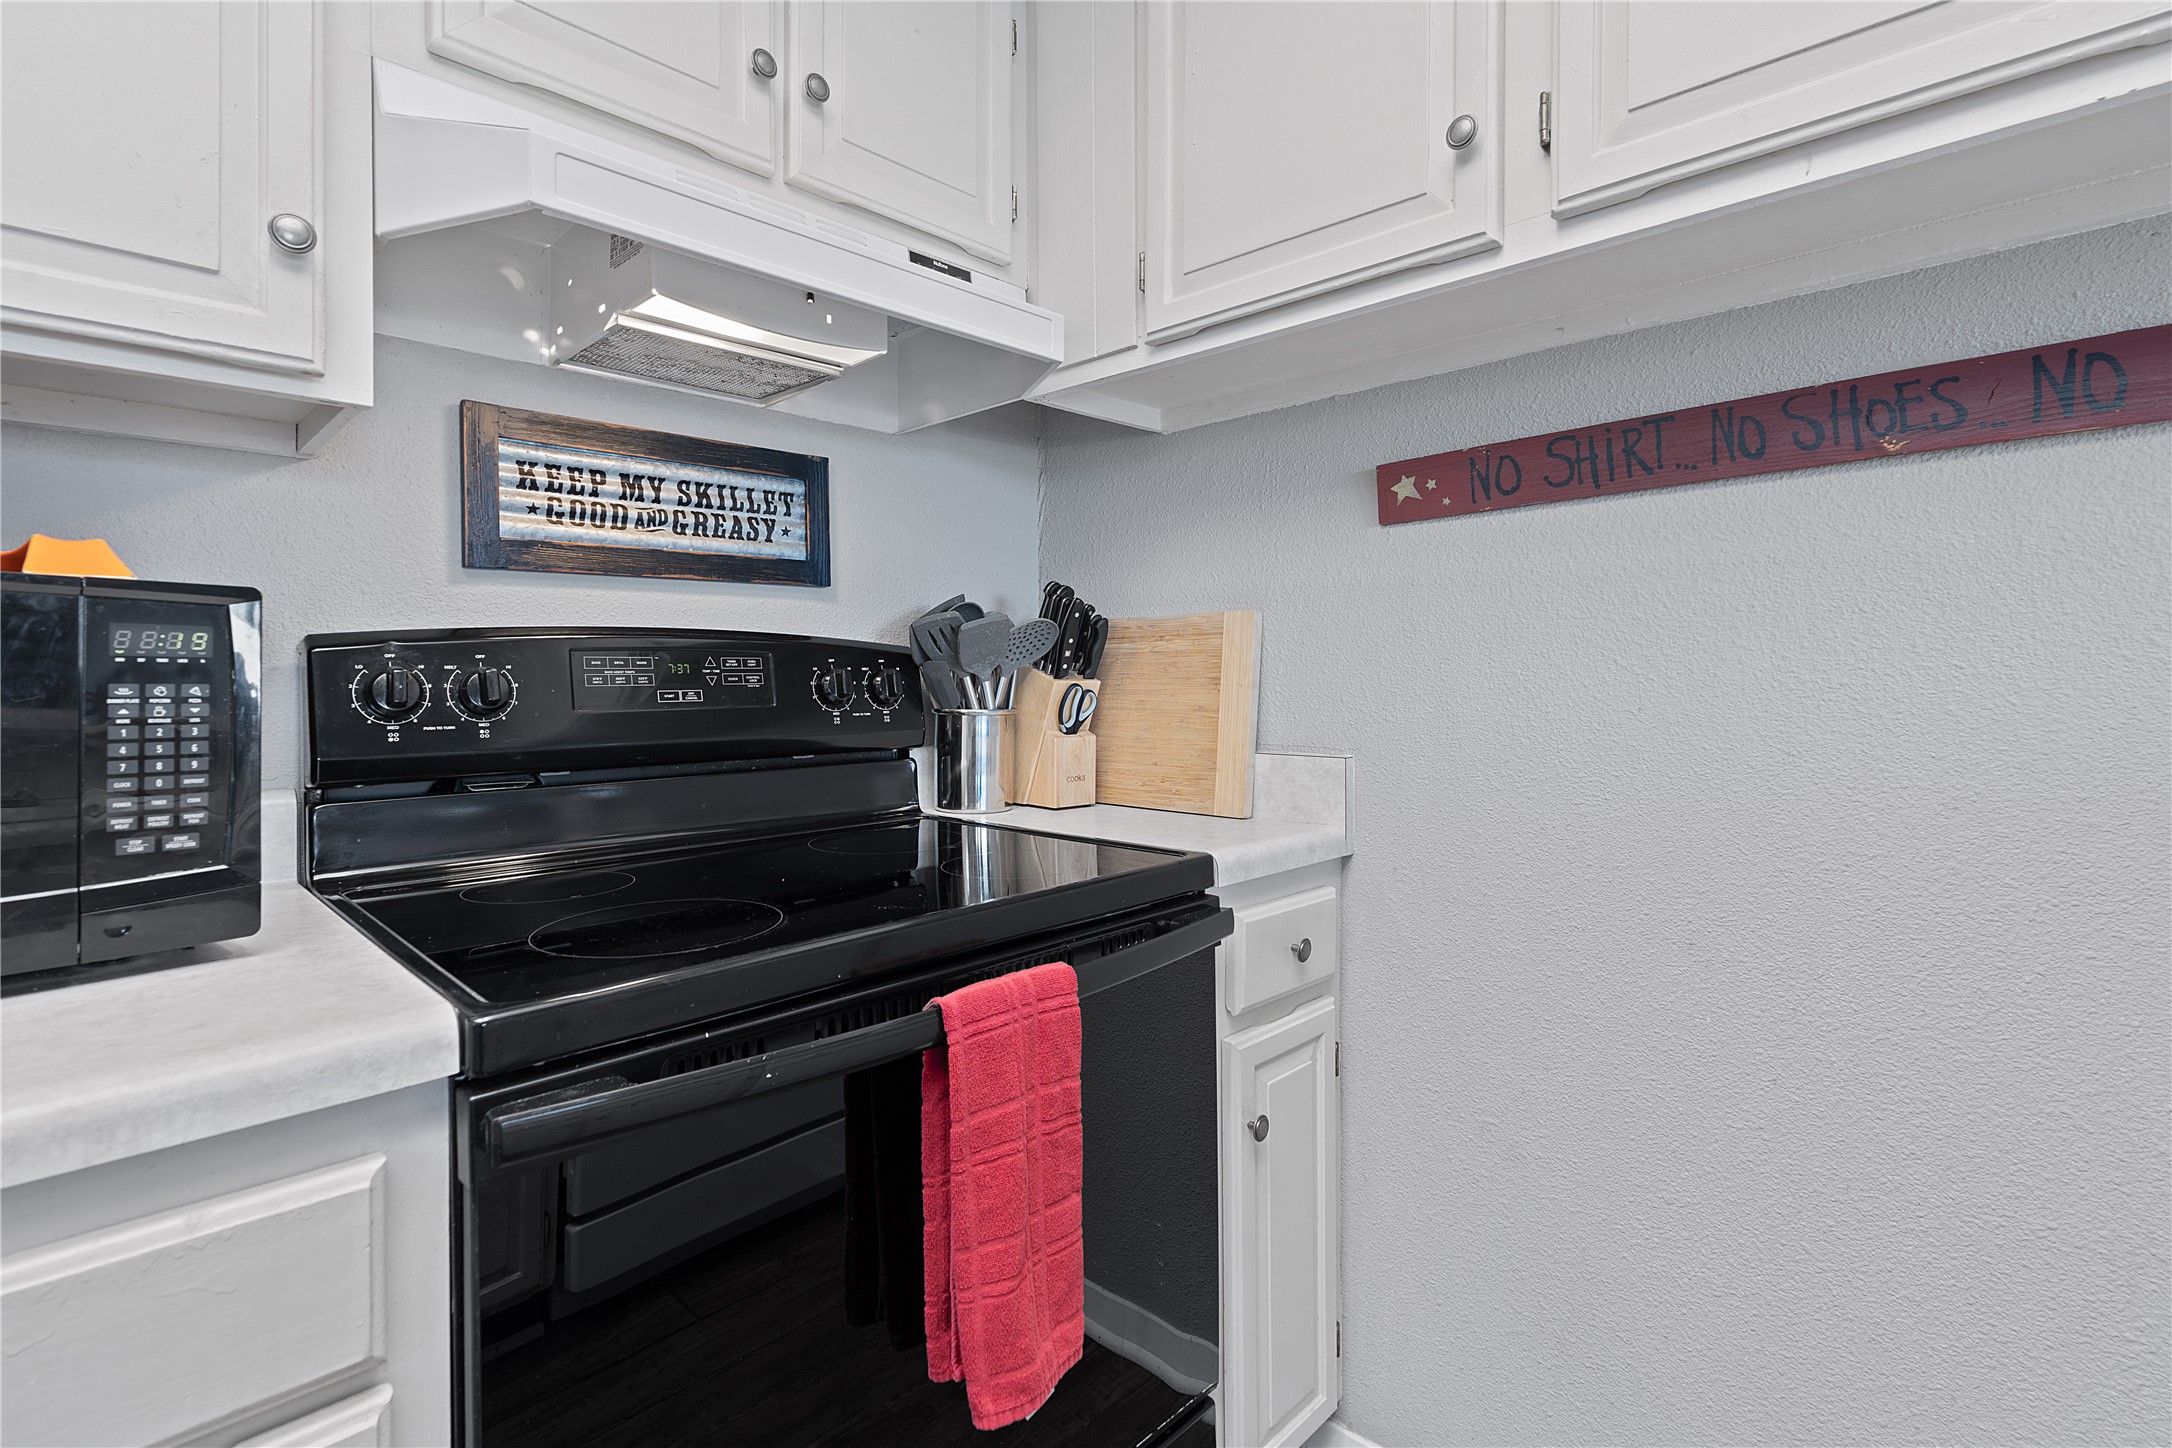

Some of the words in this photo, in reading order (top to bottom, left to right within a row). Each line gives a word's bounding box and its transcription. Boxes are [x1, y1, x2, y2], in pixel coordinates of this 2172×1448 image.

[1468, 448, 1523, 505] NO
[1711, 405, 1767, 465] NO
[2031, 347, 2129, 424] NO
[515, 460, 607, 498] KEEP
[618, 472, 666, 504] MY
[677, 479, 795, 518] SKILLET
[546, 496, 629, 531] GOOD
[633, 507, 669, 530] AND
[672, 509, 776, 543] GREASY
[668, 664, 690, 674] 7:37
[120, 728, 126, 737] 1
[156, 728, 164, 737] 2
[191, 727, 198, 736] 3
[119, 746, 127, 754] 4
[156, 744, 163, 754] 5
[191, 743, 198, 752] 6
[119, 764, 126, 772] 7
[156, 762, 163, 770] 8
[191, 760, 198, 769] 9
[155, 778, 162, 788] 0
